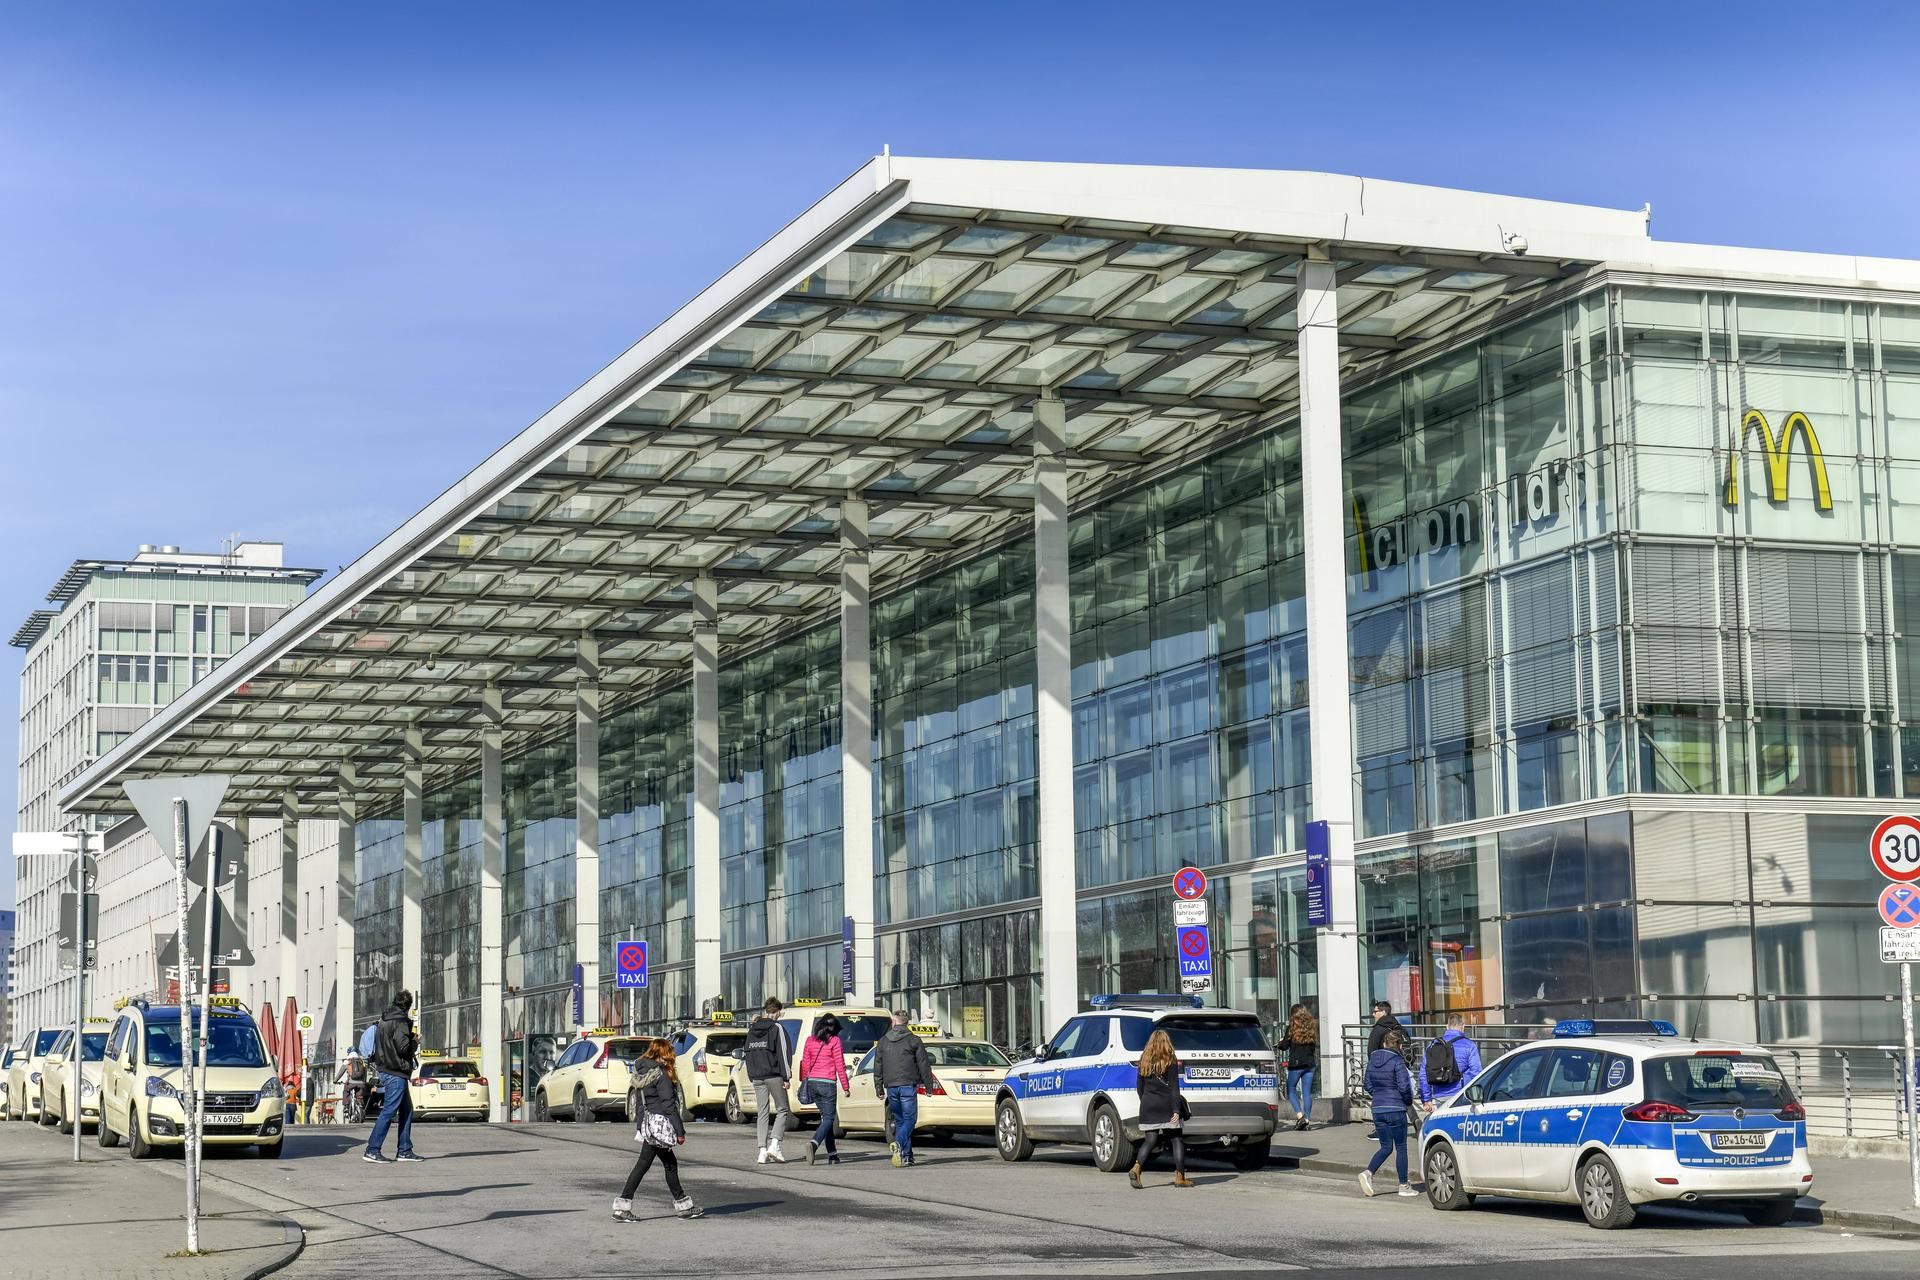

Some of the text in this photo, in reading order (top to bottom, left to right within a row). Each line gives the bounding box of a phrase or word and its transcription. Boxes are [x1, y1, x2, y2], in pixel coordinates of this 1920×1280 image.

[1885, 834, 1920, 863] 30
[1183, 960, 1208, 972] TAXI
[620, 973, 645, 984] TAXI
[1191, 1068, 1201, 1077] BP
[1028, 1075, 1054, 1092] POLIZEI
[1244, 1078, 1274, 1087] POLIZEI
[1466, 1121, 1503, 1137] POLIZEI
[1717, 1135, 1729, 1145] BP
[1723, 1155, 1758, 1166] POLIZEI
